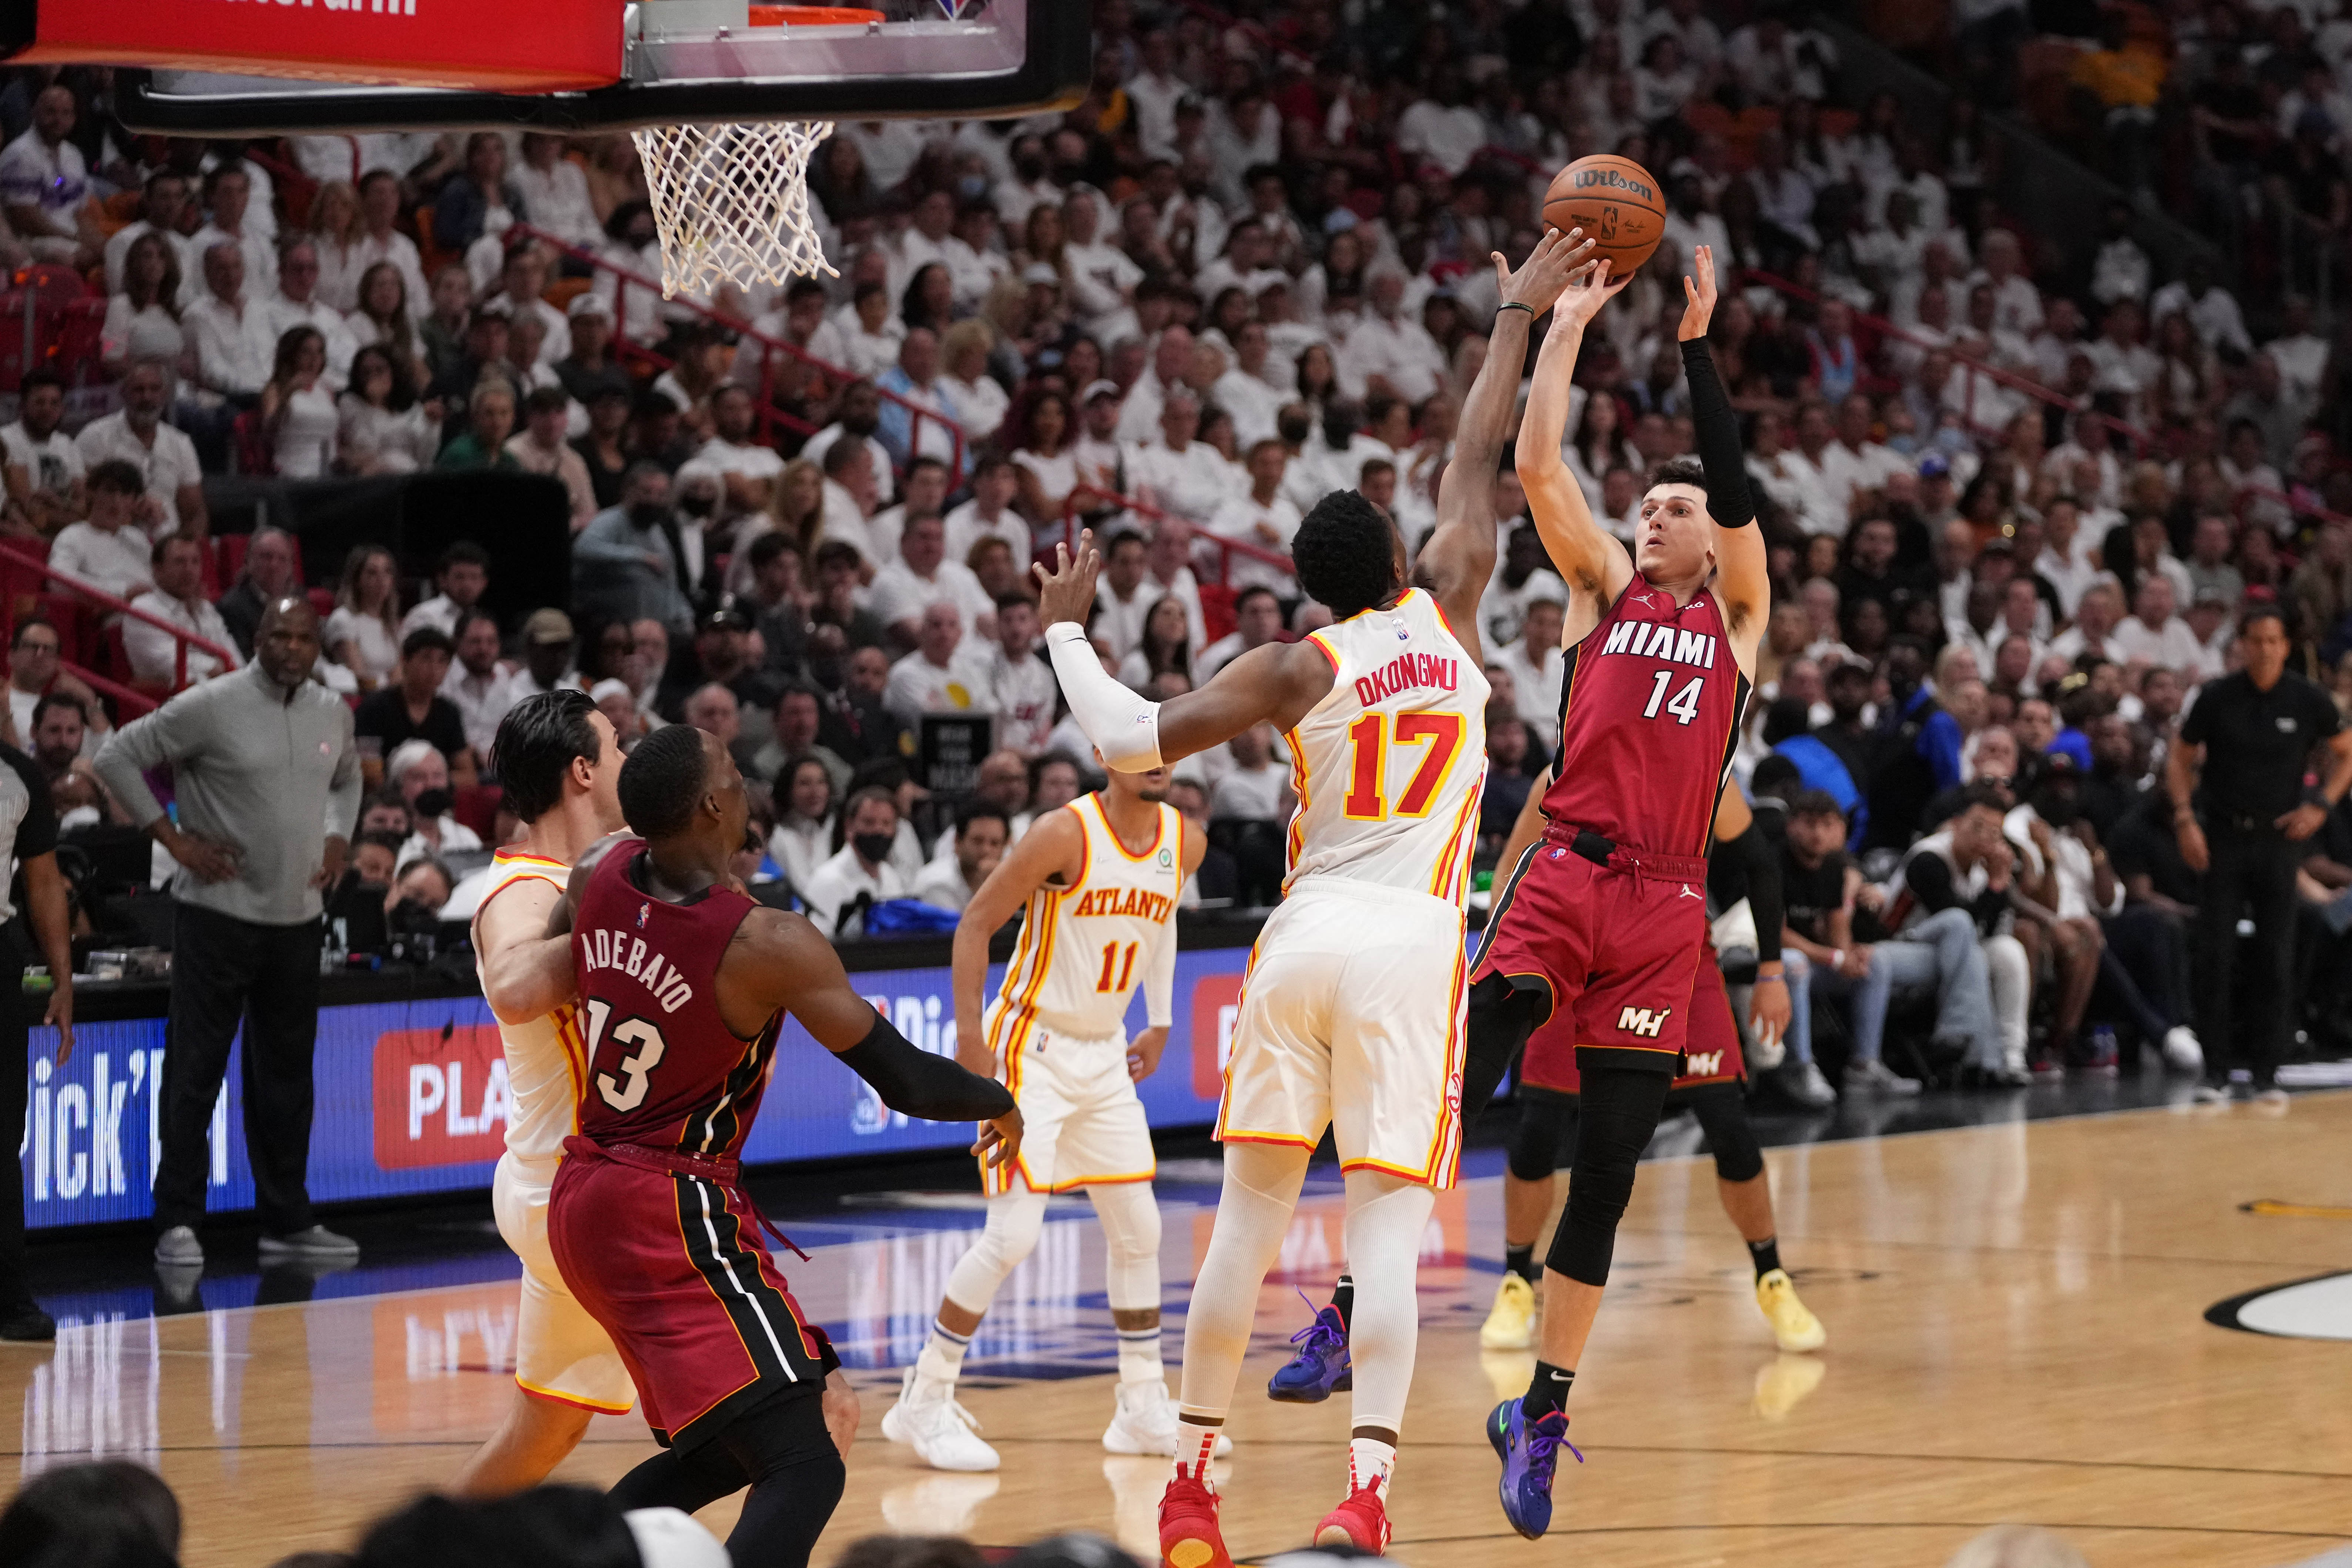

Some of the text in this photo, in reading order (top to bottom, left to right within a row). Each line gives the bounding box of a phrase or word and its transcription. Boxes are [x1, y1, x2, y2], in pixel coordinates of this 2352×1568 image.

[1574, 169, 1653, 202] Wilson
[1601, 621, 1717, 669] MIAMI
[1355, 652, 1457, 707] OKONGWU
[1642, 669, 1705, 726] 14
[1343, 711, 1467, 822] 17
[580, 929, 693, 1014] ADEBAYO
[1096, 940, 1140, 993] 11
[587, 995, 668, 1115] 13
